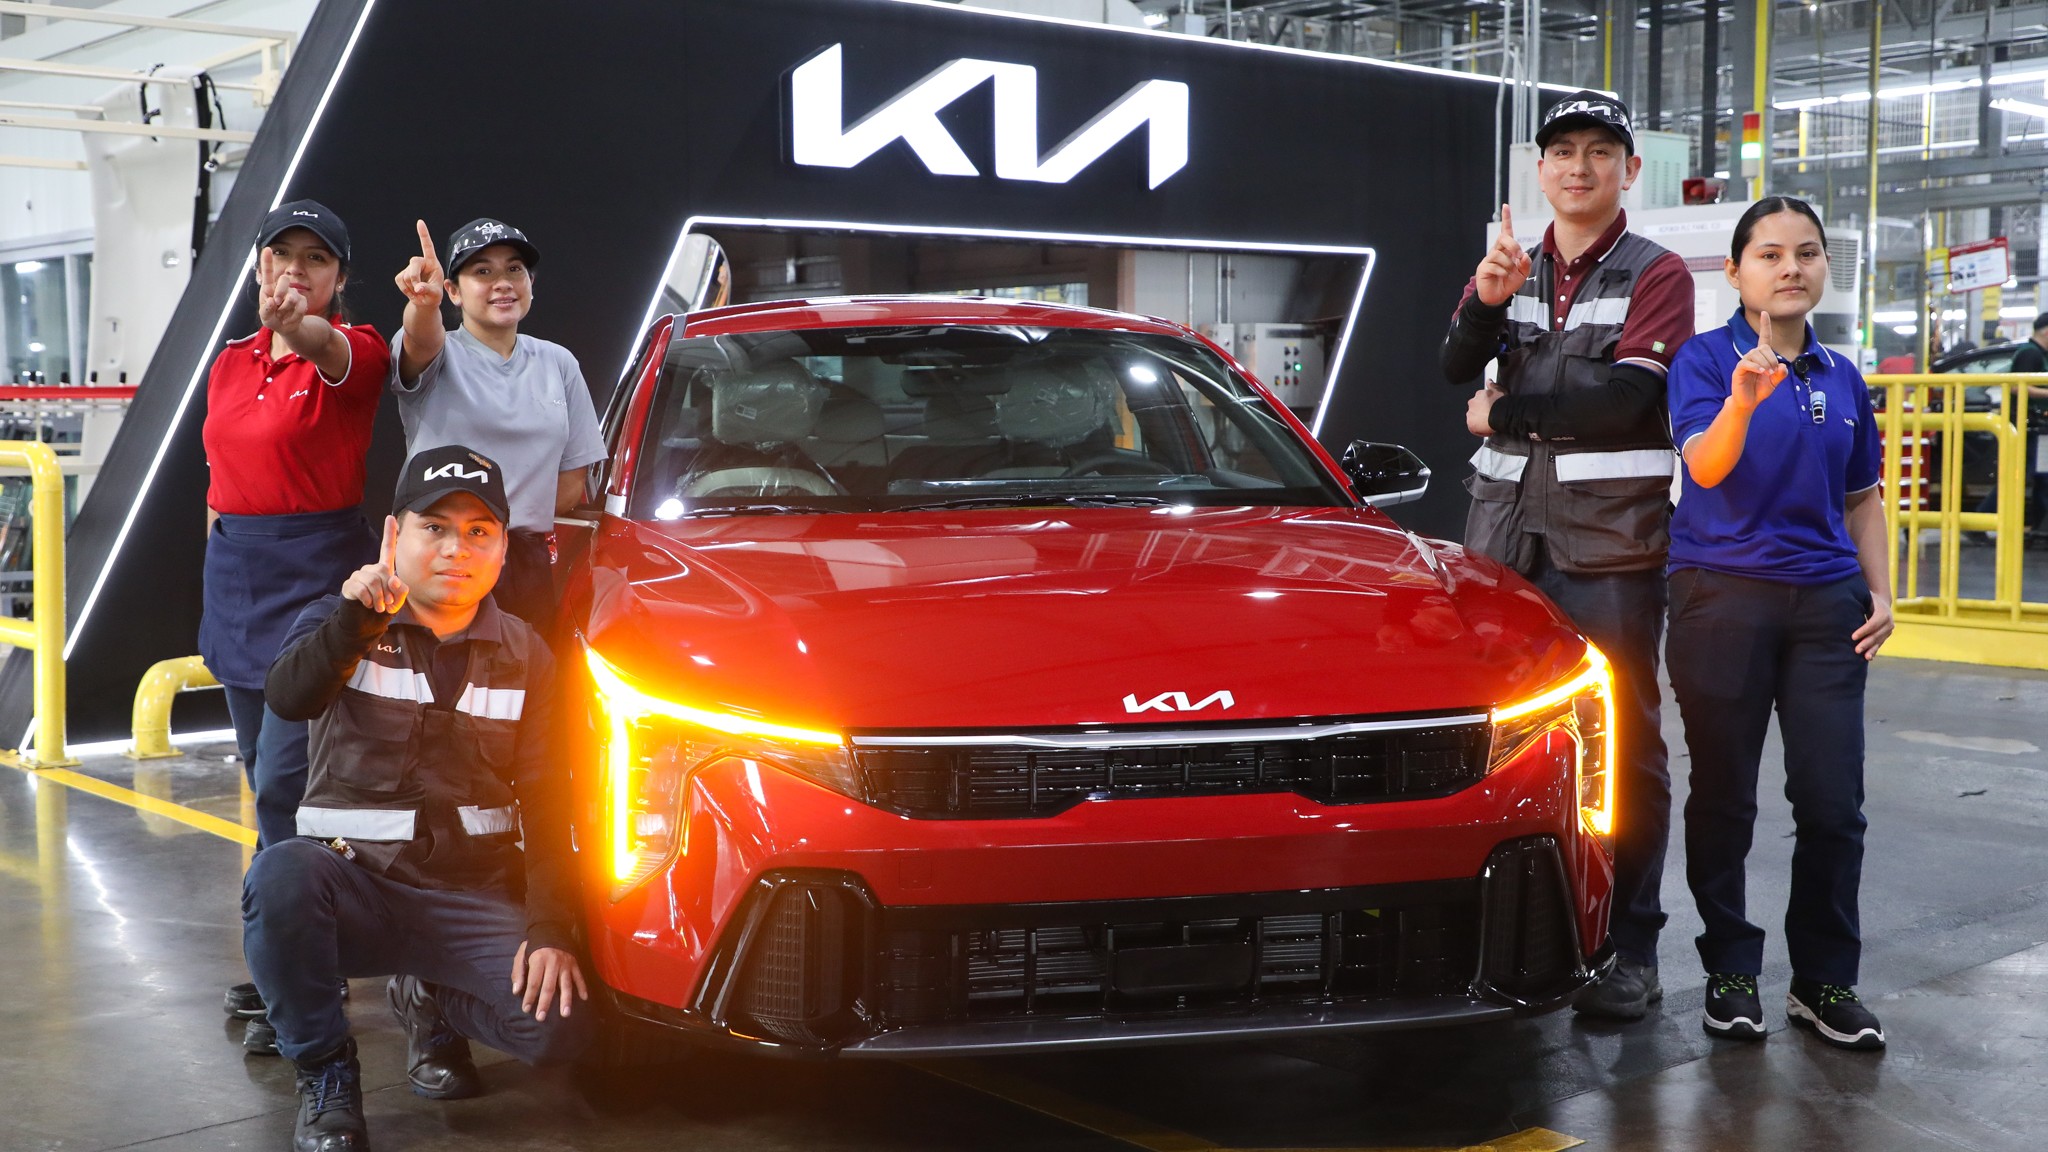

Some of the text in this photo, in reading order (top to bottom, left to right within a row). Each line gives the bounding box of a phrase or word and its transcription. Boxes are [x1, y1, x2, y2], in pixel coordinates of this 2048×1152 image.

[791, 43, 1190, 190] KIA
[1555, 100, 1611, 118] KIA
[292, 210, 319, 219] KIA
[423, 462, 489, 484] KIA
[377, 643, 402, 654] KIA
[1123, 691, 1235, 714] KIA
